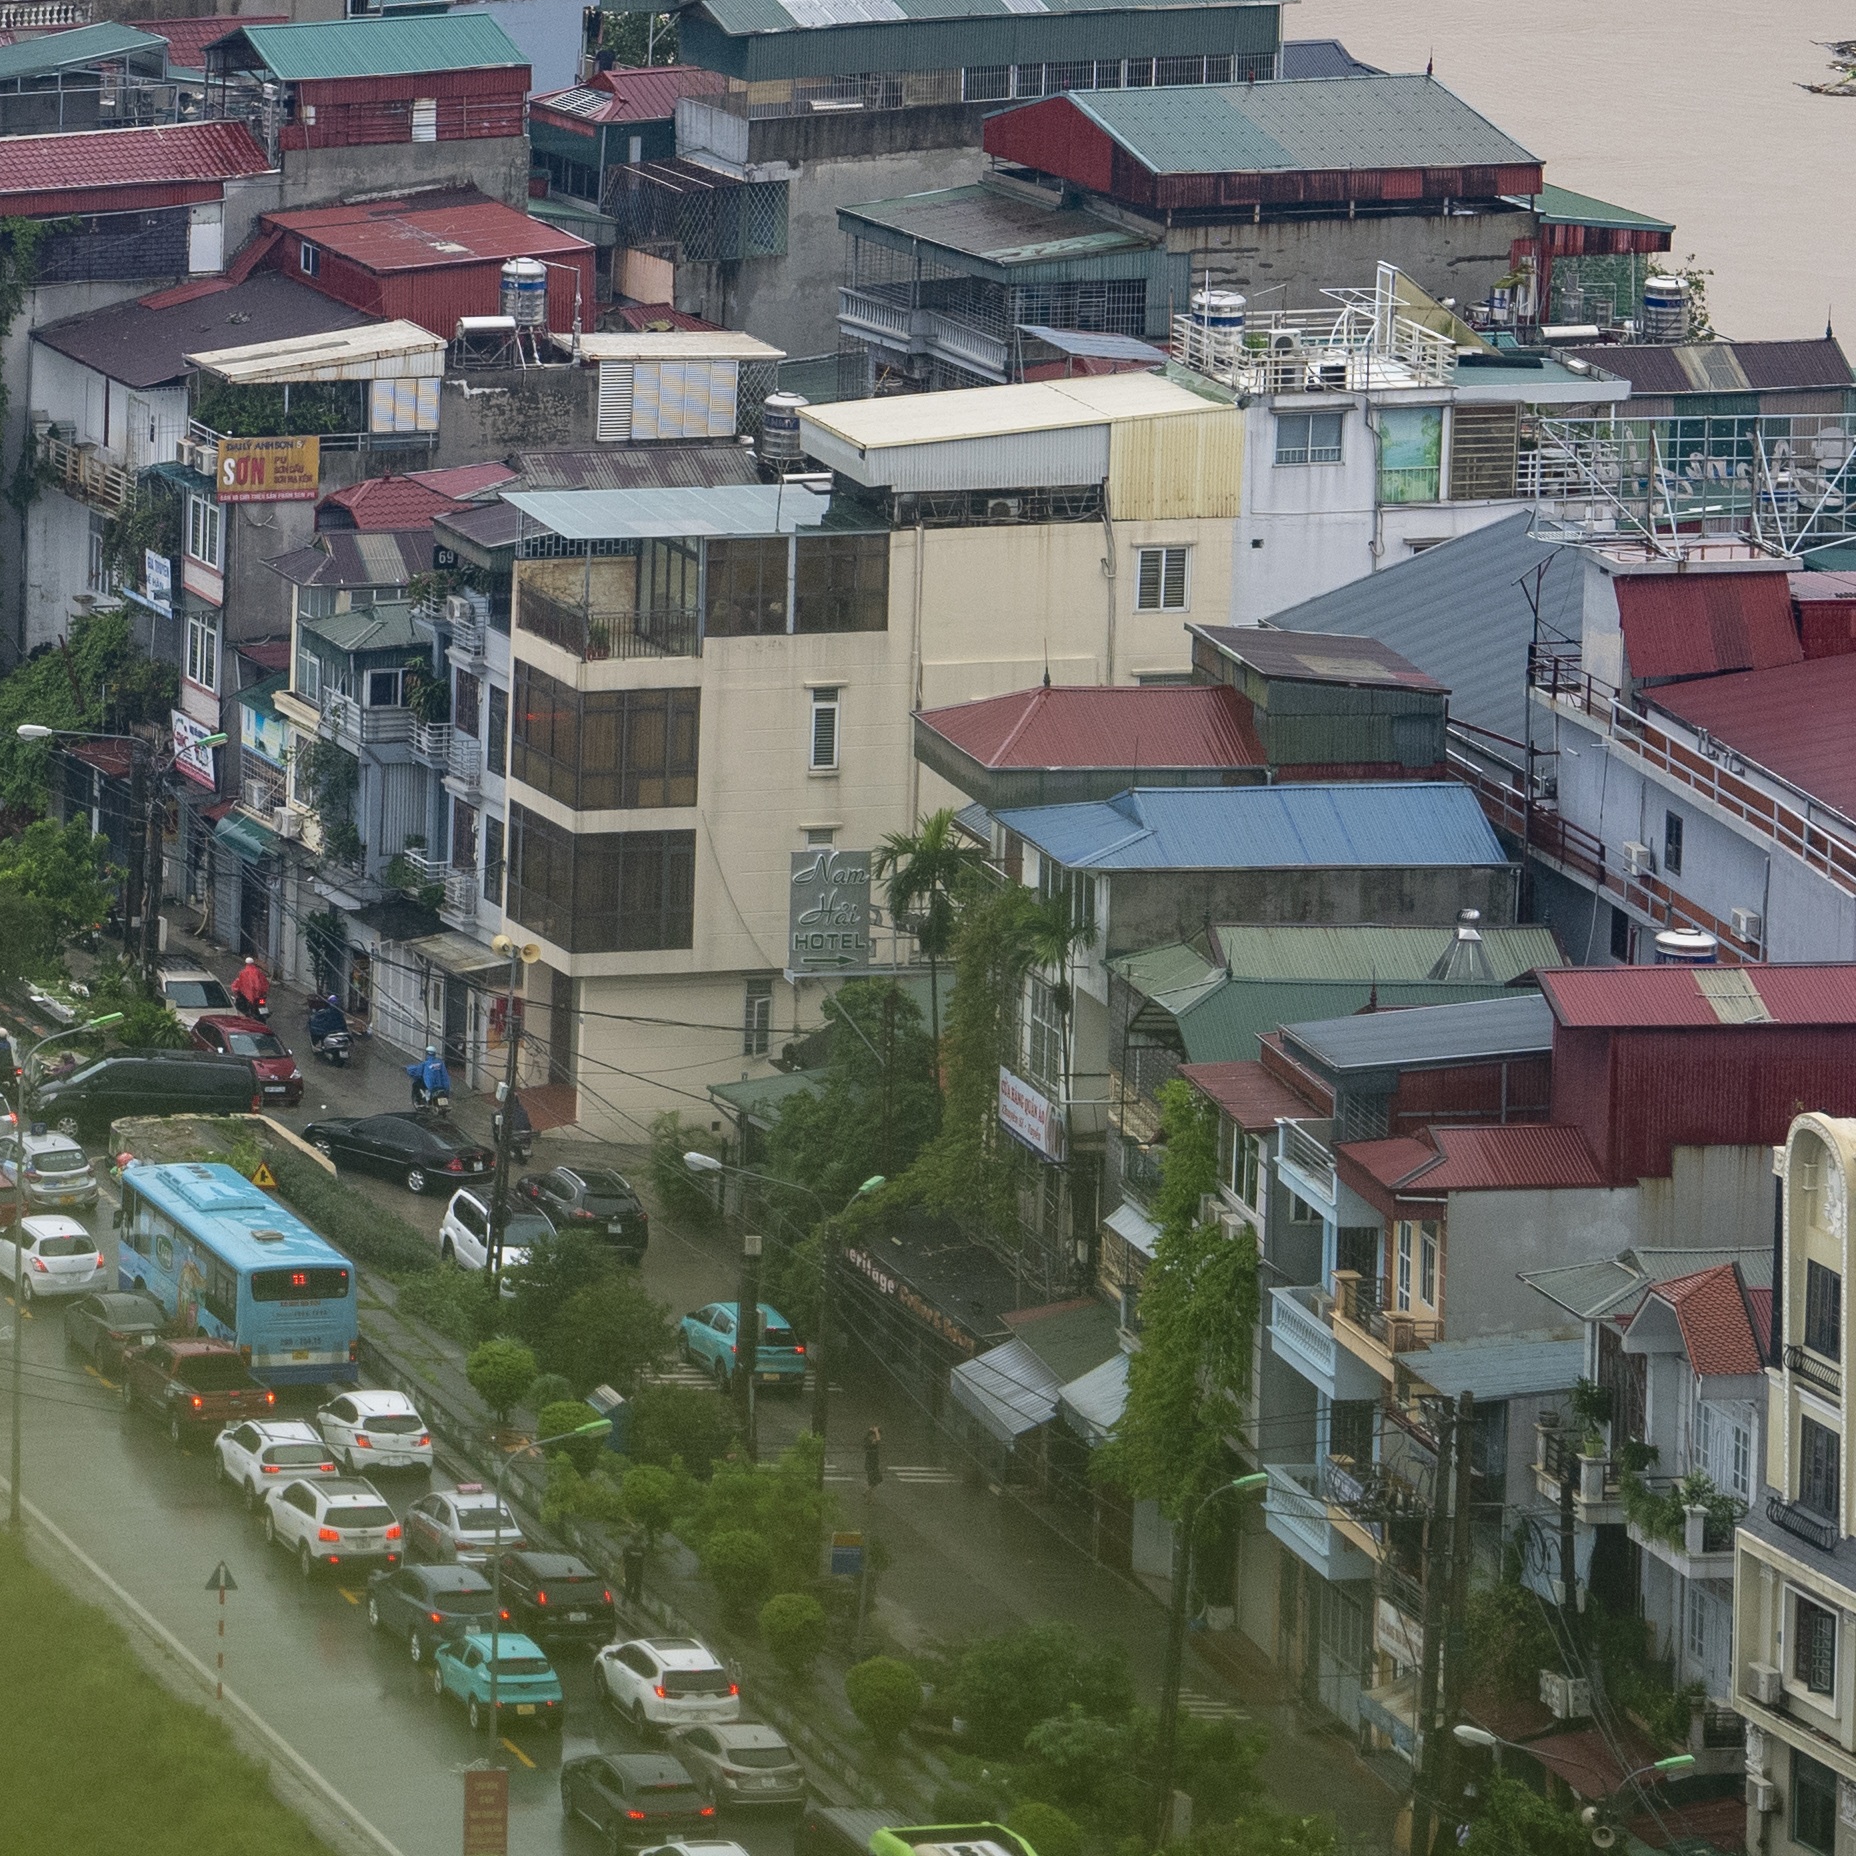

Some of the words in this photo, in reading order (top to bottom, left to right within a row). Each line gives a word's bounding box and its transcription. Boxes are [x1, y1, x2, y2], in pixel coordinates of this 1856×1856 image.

[223, 455, 266, 486] SƠN
[439, 551, 454, 564] 69
[793, 851, 870, 884] Nam
[799, 888, 861, 925] Hải
[793, 932, 866, 950] HOTEL
